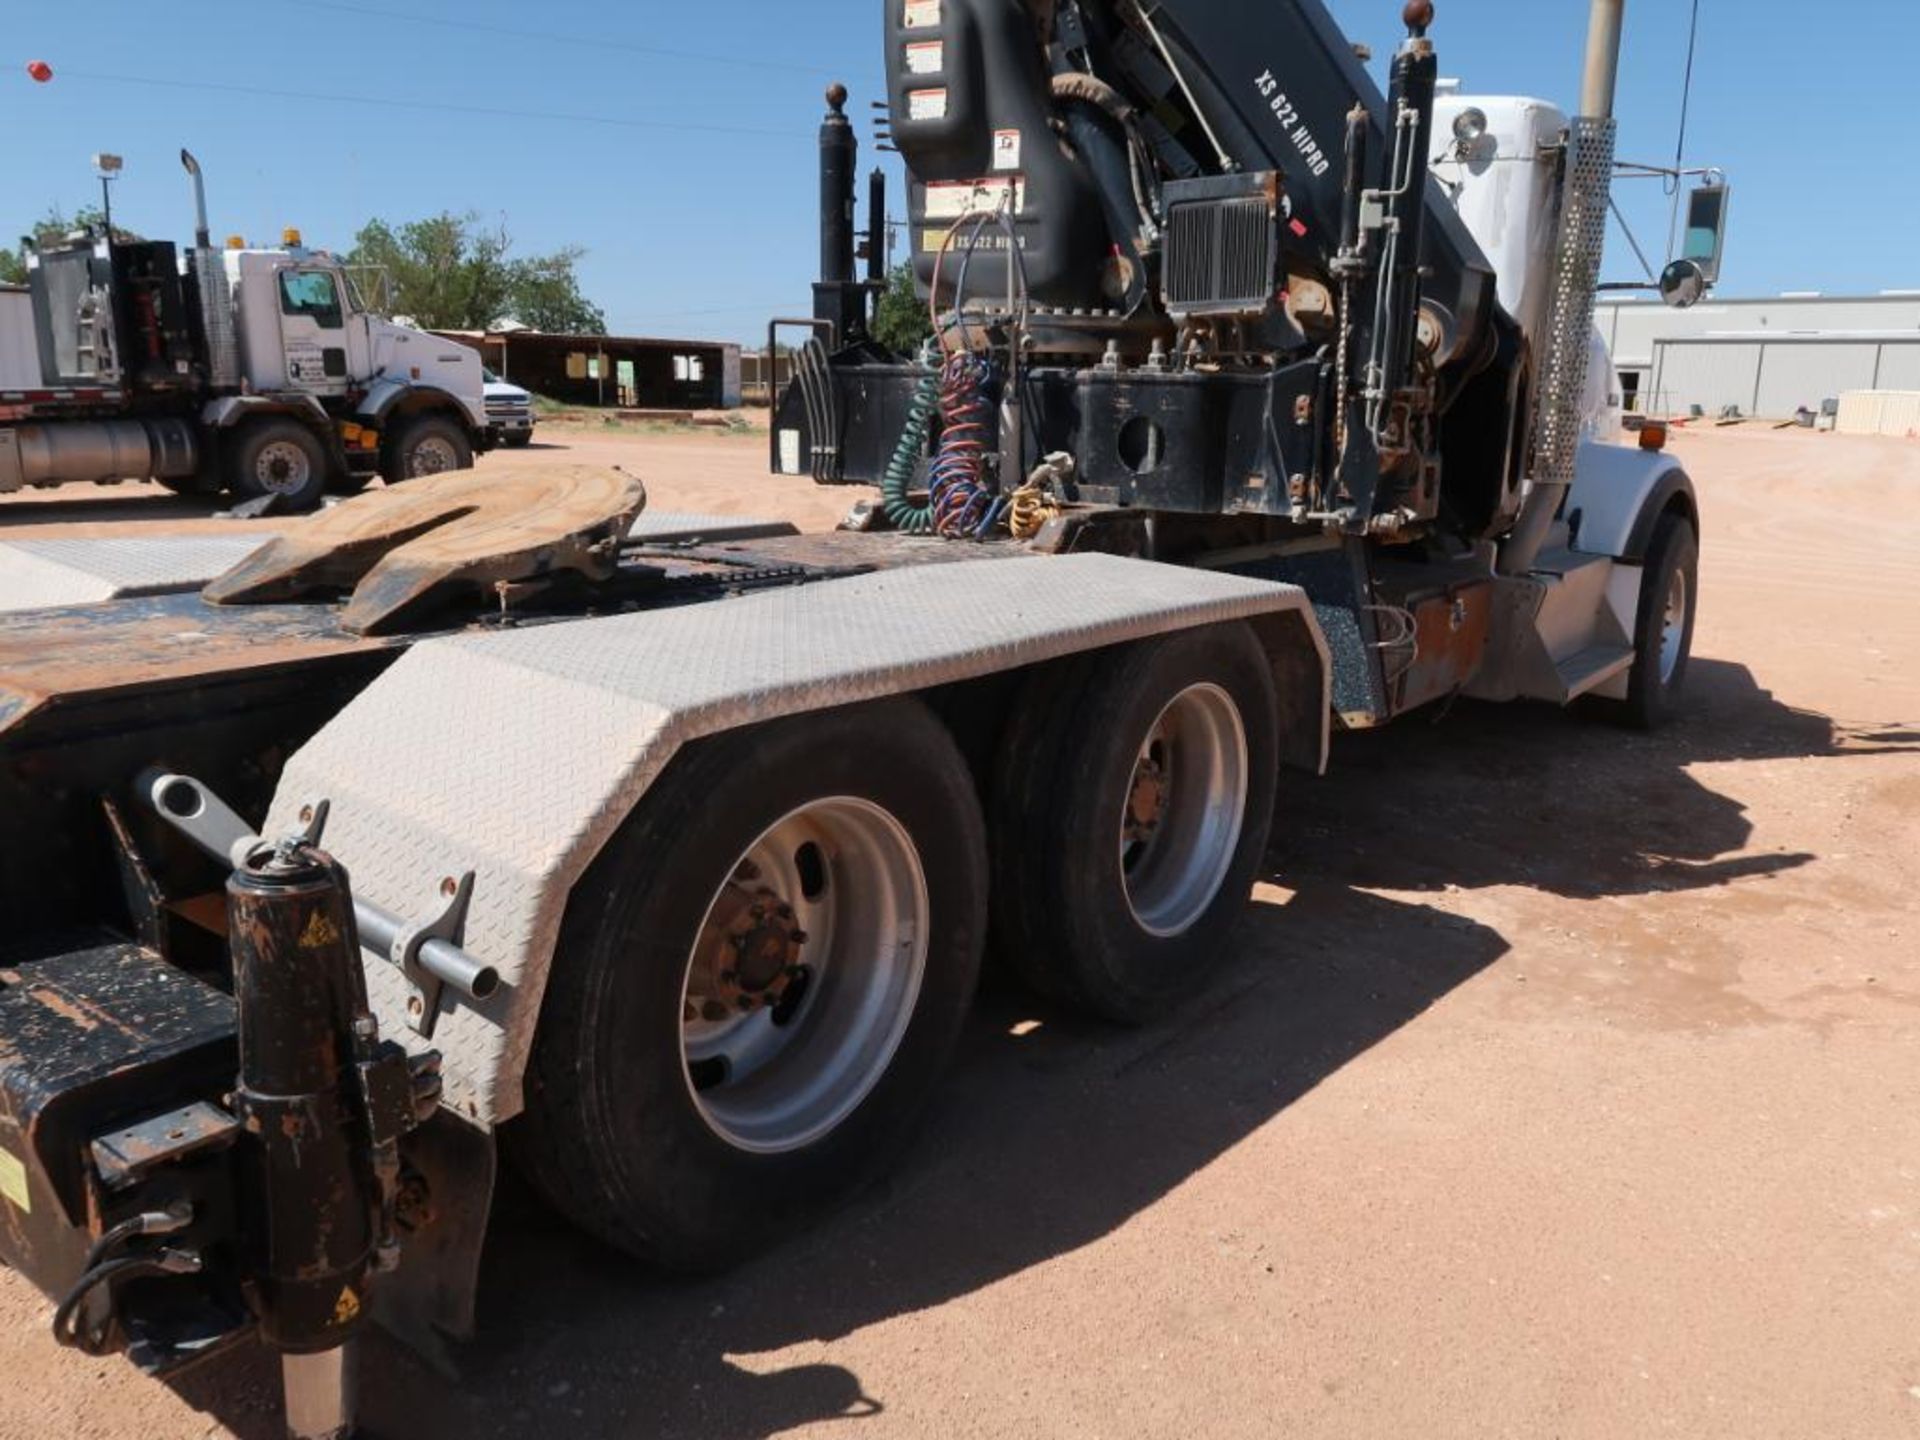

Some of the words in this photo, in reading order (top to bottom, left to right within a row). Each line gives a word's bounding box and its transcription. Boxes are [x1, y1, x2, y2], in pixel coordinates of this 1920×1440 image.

[1254, 69, 1277, 96] XS
[1270, 94, 1298, 130] 622
[1290, 125, 1329, 176] HIPRO
